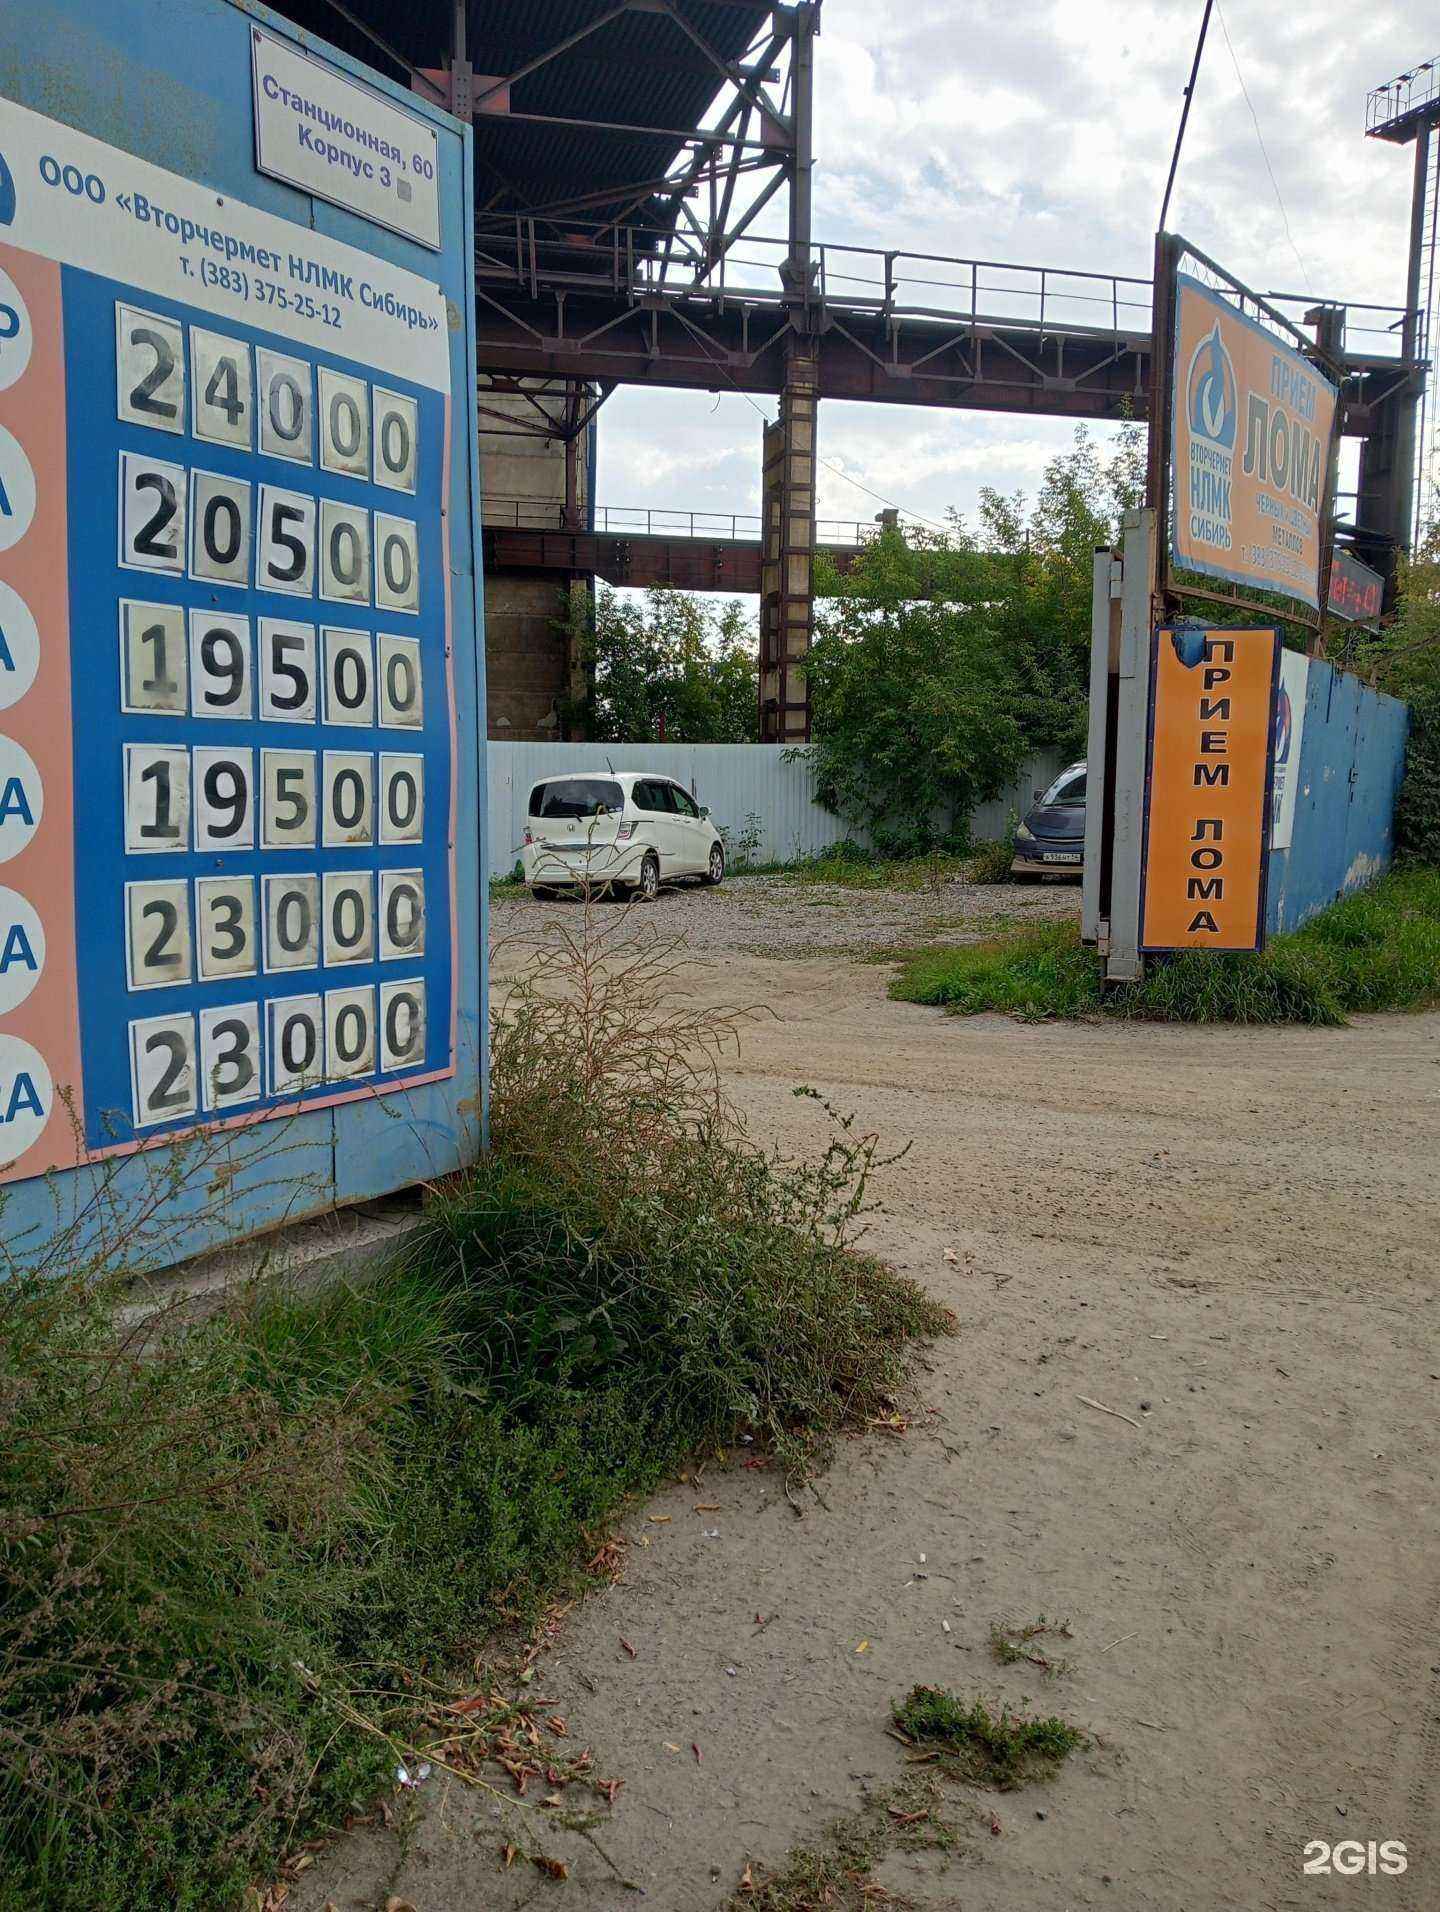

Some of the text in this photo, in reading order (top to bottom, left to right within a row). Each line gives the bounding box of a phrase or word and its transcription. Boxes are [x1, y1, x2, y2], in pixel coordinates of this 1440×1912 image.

[262, 74, 433, 180] Станционная, 60
[298, 123, 391, 187] Корпус 3
[40, 155, 439, 331] ООО «Вторчермет НЛМК Сибирь»
[200, 258, 248, 301] (383)
[254, 278, 342, 329] 375-25-12
[130, 328, 410, 473] 24000
[1191, 442, 1231, 476] ВТОРЧЕРМЕТ
[1191, 465, 1231, 520] НЛМК
[1243, 392, 1320, 518] ЛОМА
[133, 472, 412, 594] 20500
[1191, 515, 1231, 548] СИБИРЬ
[141, 623, 416, 712] 19500
[140, 760, 416, 839] 19500
[1186, 638, 1235, 935] ПРИЕМ ЛОМА
[142, 883, 419, 968] 23000
[145, 992, 422, 1111] 23000
